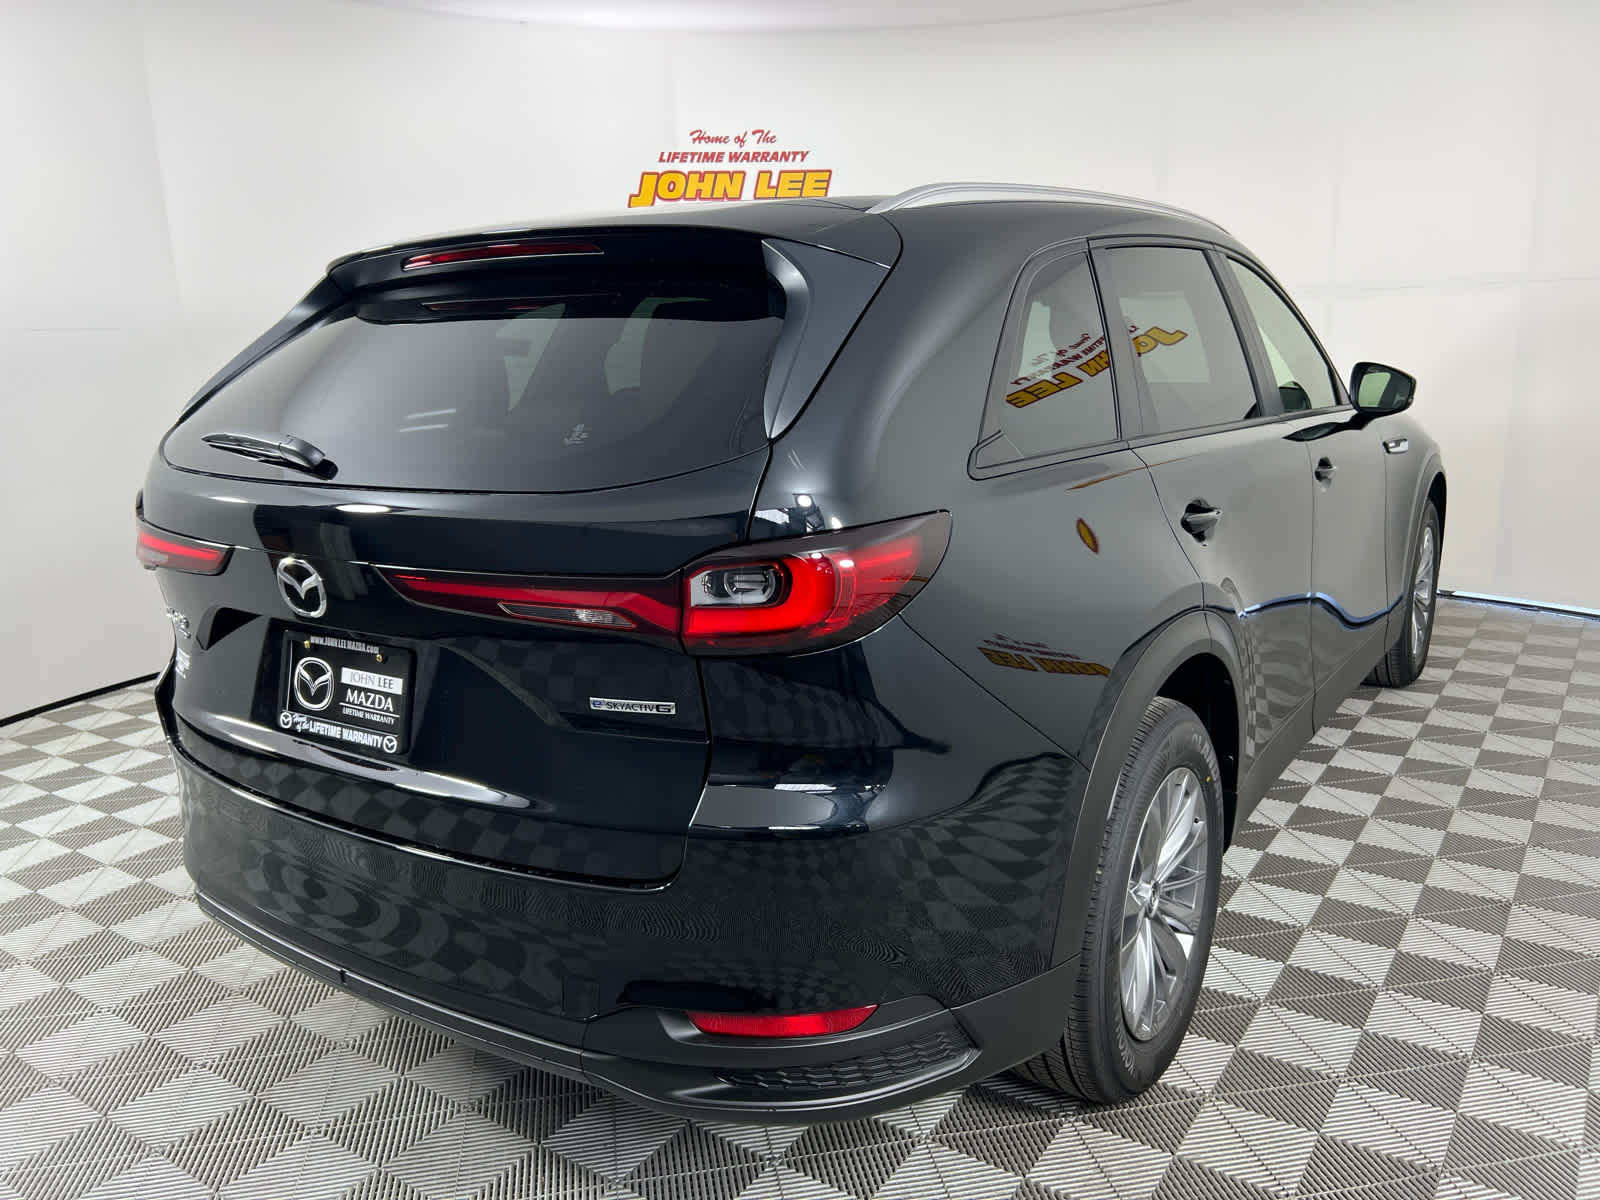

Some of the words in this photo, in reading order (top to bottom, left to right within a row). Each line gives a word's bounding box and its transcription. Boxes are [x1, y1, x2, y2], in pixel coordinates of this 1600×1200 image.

[689, 129, 730, 144] Home
[733, 131, 746, 148] of
[751, 129, 776, 144] The
[658, 152, 724, 164] LIFETIME
[728, 151, 809, 163] WARRANTY
[627, 170, 746, 208] JOHN
[753, 170, 832, 200] LEE
[350, 672, 375, 685] JOHN
[377, 678, 394, 690] LEE
[345, 688, 394, 712] MAZDA
[342, 707, 364, 719] LIFETIME
[365, 712, 394, 725] WARRANTY
[309, 721, 341, 739] LIFETIME
[342, 727, 384, 748] WARRANTY
